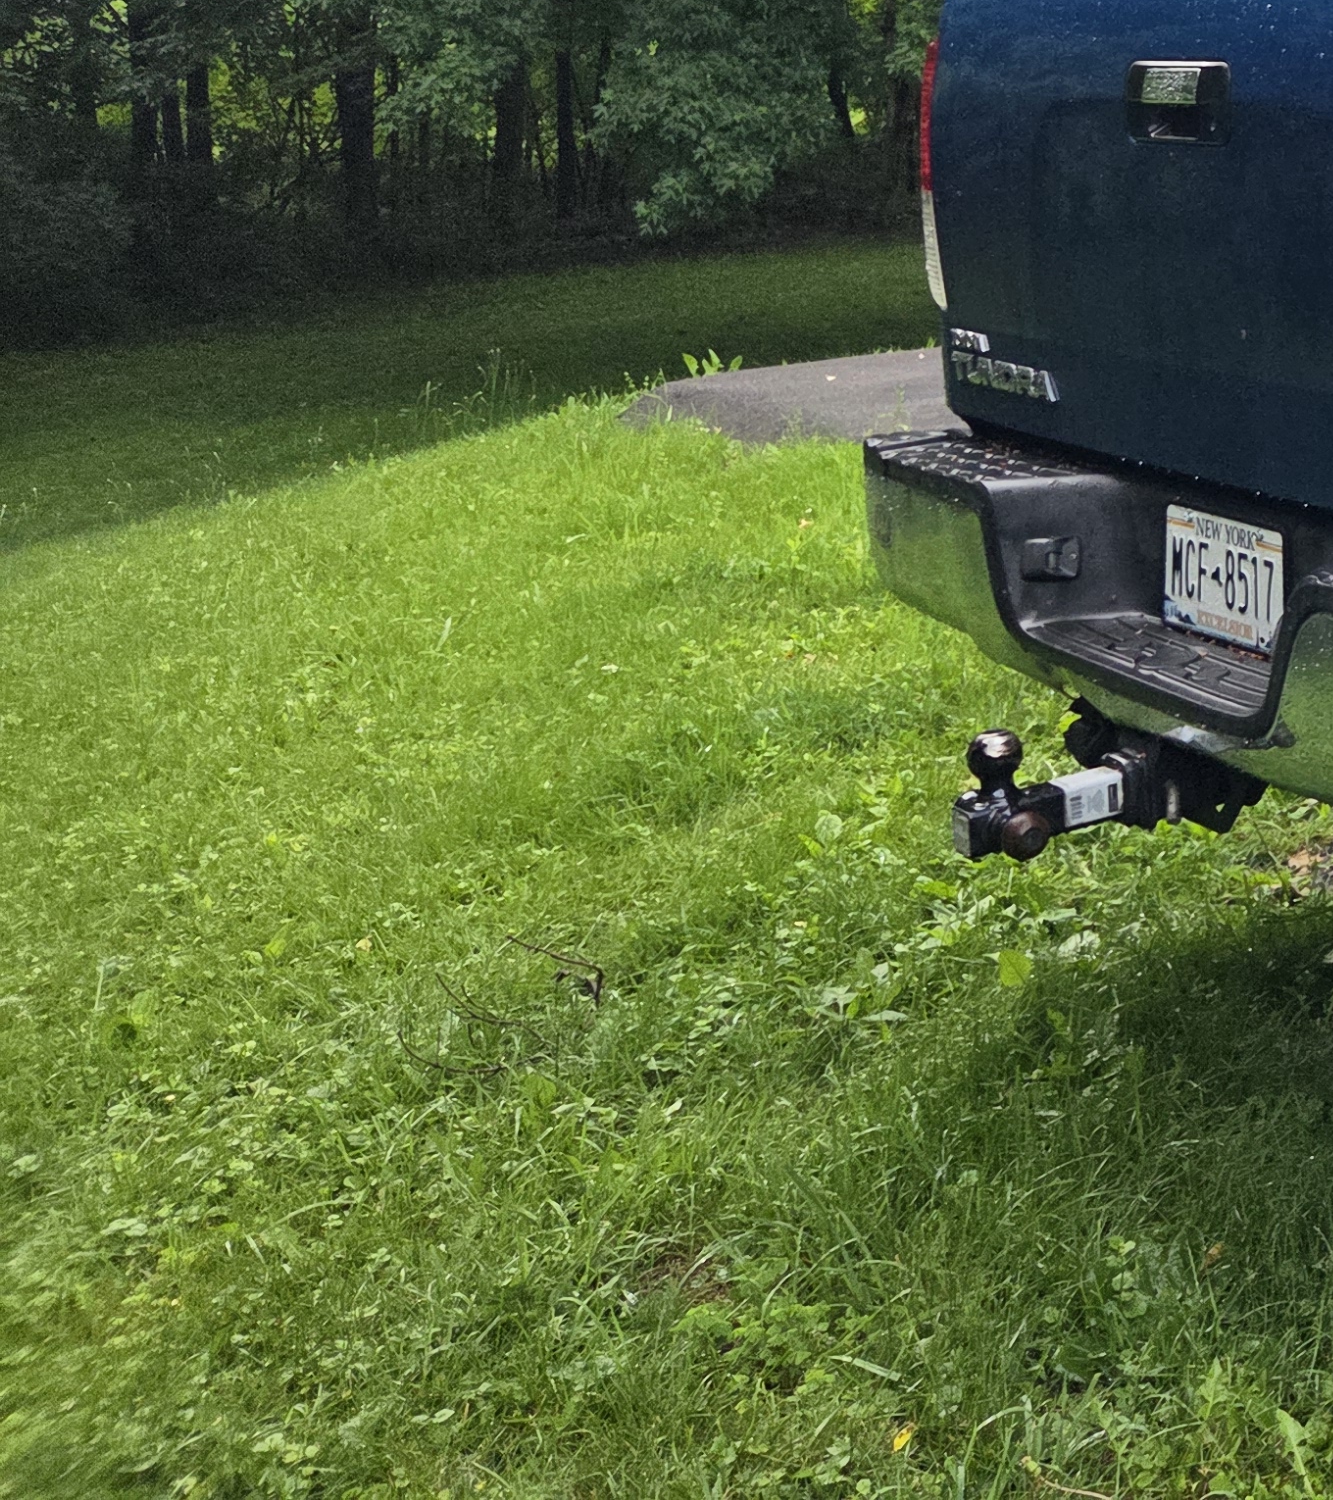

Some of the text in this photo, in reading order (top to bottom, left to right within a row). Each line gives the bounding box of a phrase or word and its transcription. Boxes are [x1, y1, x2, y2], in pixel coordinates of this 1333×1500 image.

[1195, 517, 1257, 552] NEW YORK
[1171, 535, 1274, 624] MCF 8517
